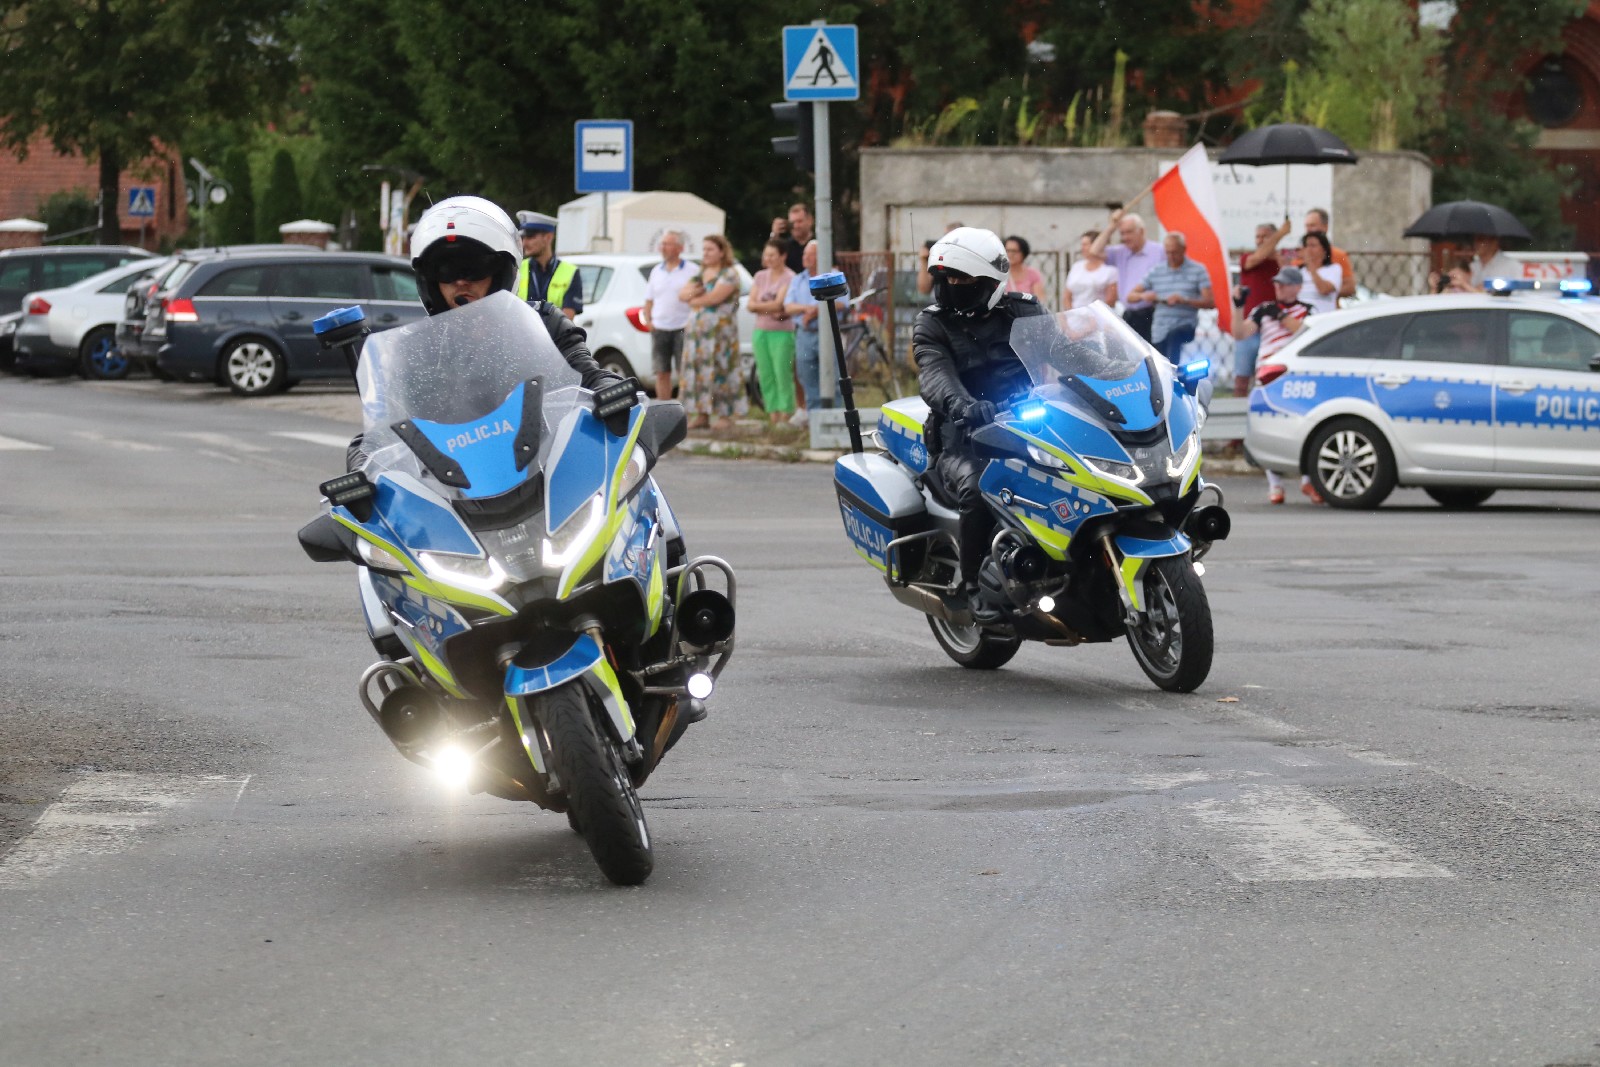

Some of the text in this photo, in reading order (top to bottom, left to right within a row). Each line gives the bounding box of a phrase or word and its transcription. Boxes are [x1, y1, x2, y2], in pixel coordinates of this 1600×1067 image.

[1105, 381, 1148, 400] POLICJA
[1282, 380, 1317, 399] B818
[446, 420, 514, 453] POLICJA
[843, 509, 888, 554] POLICJA
